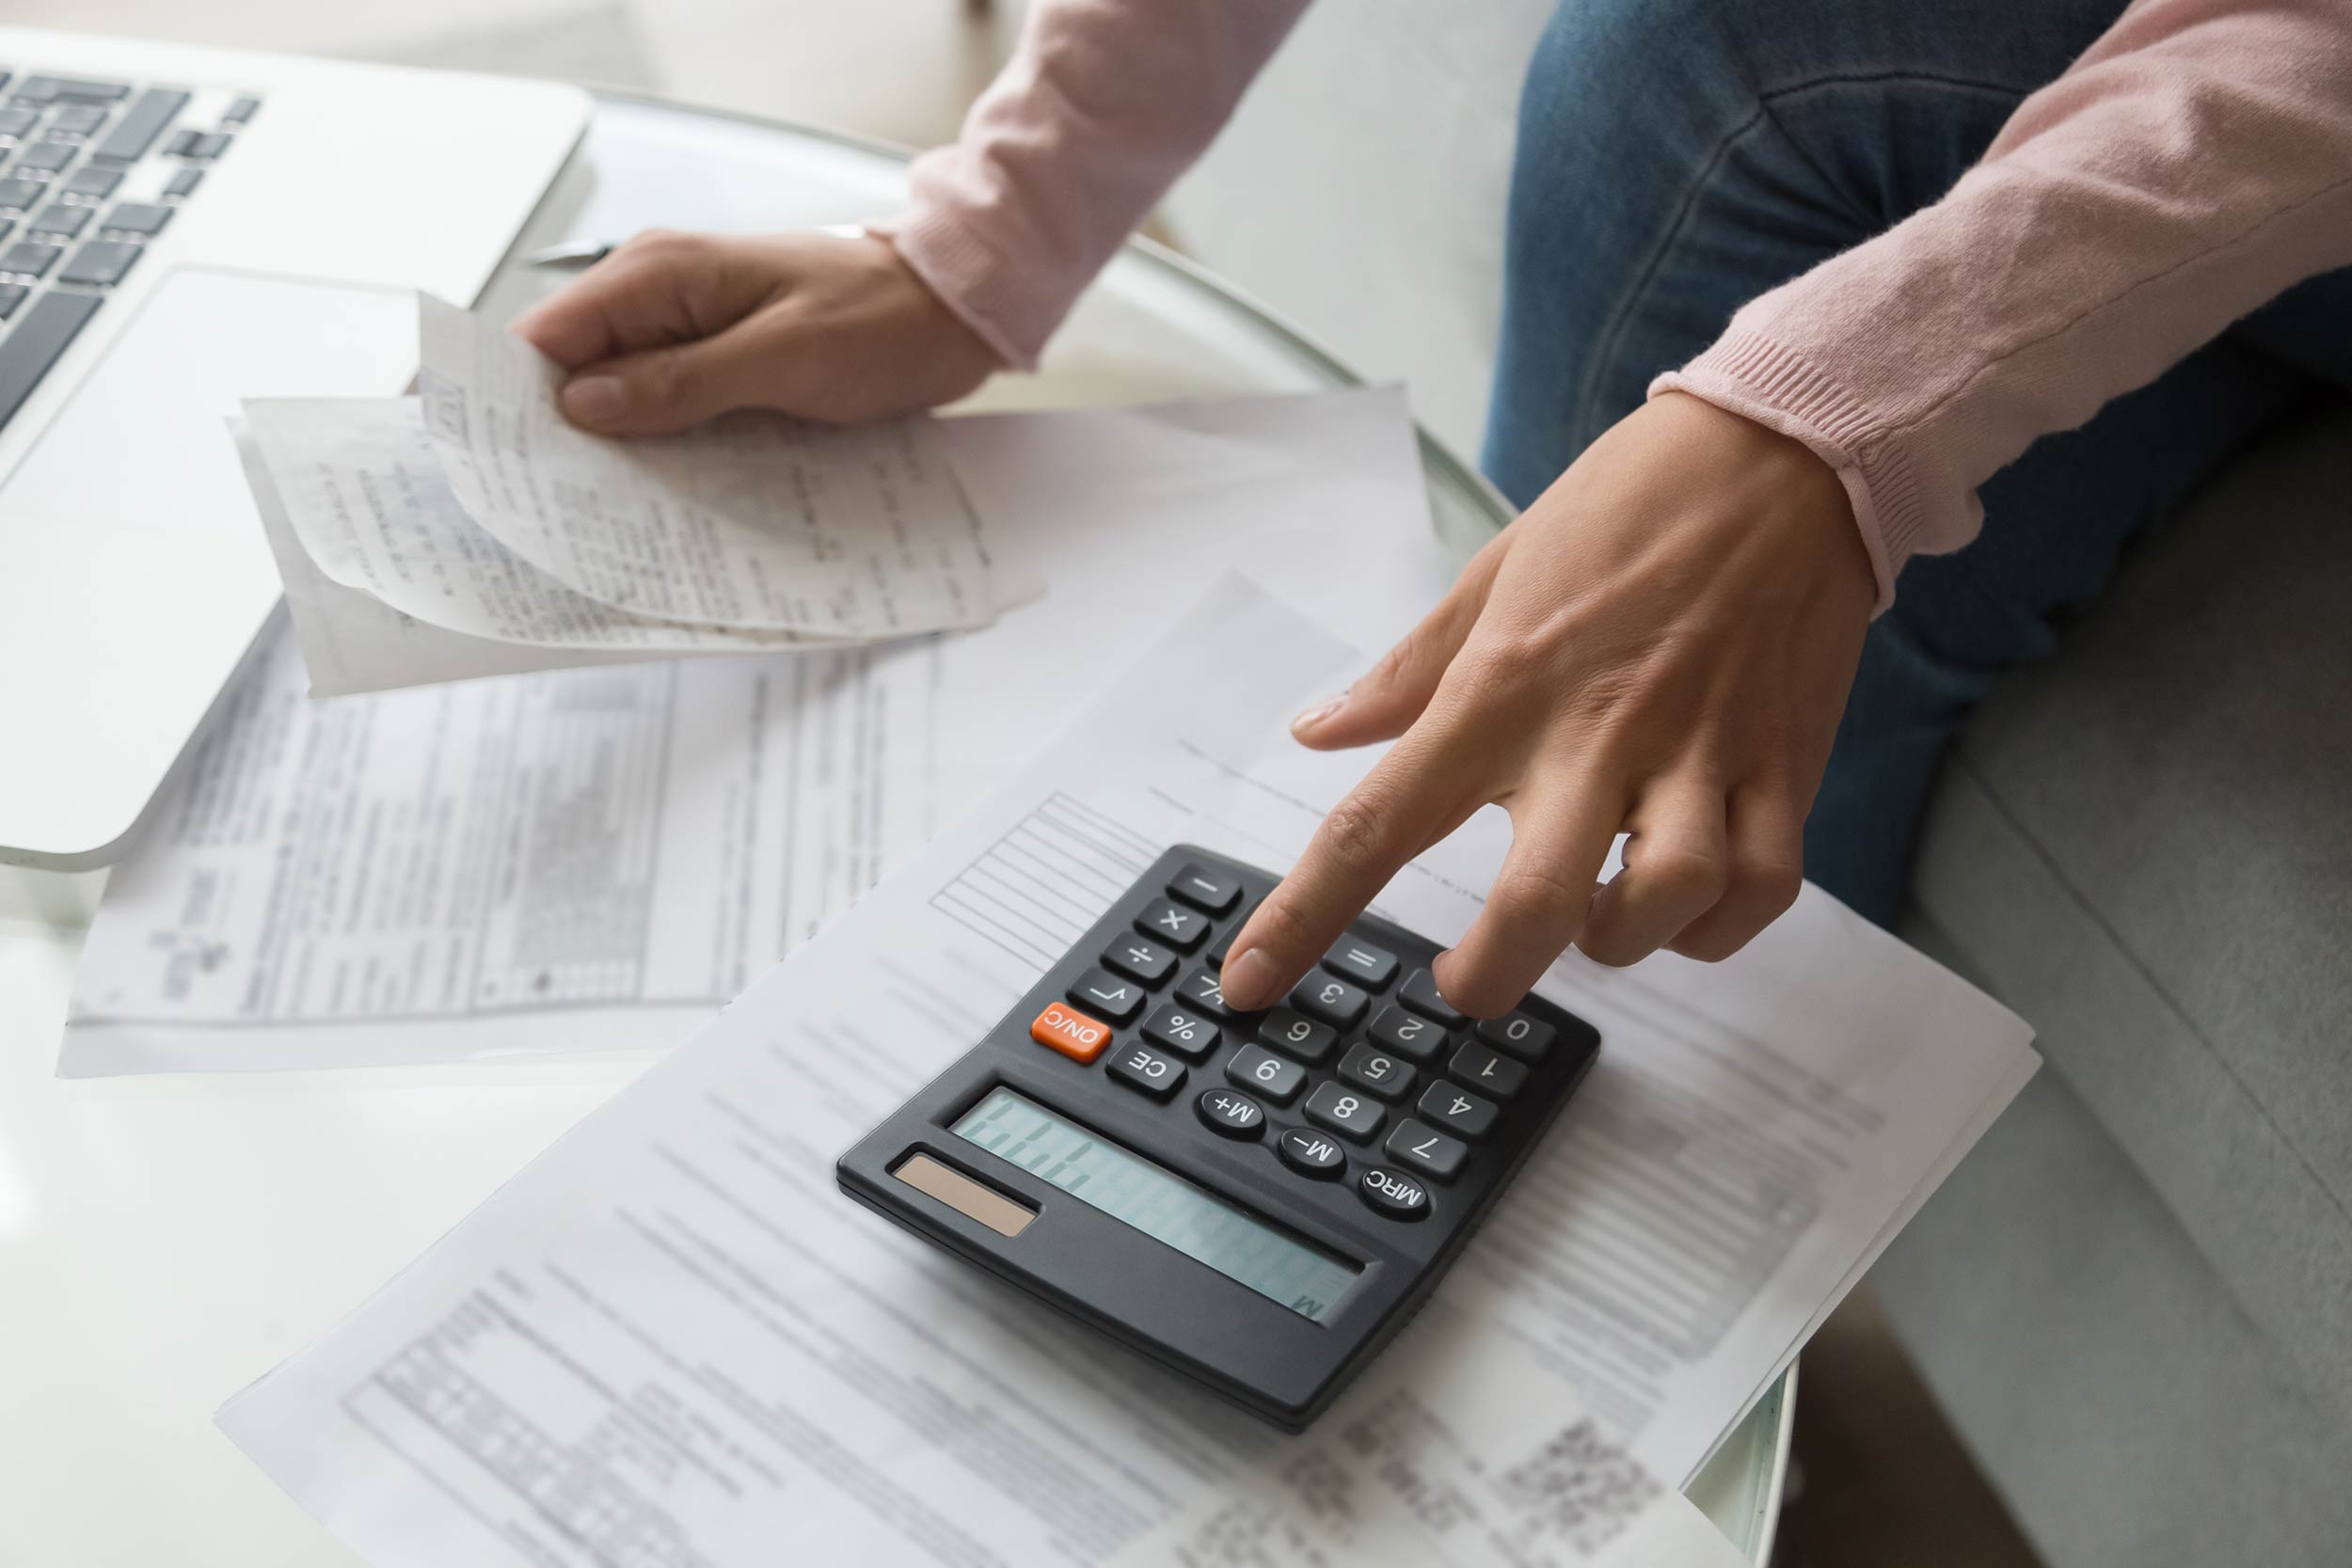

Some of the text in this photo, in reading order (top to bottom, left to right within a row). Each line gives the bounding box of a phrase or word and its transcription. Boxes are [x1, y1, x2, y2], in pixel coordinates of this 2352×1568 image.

[1320, 983, 1344, 1004] 3
[1043, 1009, 1100, 1044] ON/C
[1169, 1015, 1196, 1040] %
[1286, 1022, 1311, 1042] 6
[1398, 1018, 1424, 1040] 2
[1506, 1019, 1530, 1040] 0
[1128, 1051, 1168, 1078] CE
[1255, 1059, 1281, 1081] 9
[1364, 1057, 1391, 1080] 5
[1481, 1058, 1498, 1077] 1
[1215, 1097, 1255, 1123] M+
[1333, 1097, 1359, 1118] 8
[1448, 1096, 1472, 1116] 4
[1411, 1136, 1438, 1159] 7
[1366, 1169, 1422, 1207] MRC
[1291, 1293, 1325, 1318] M
